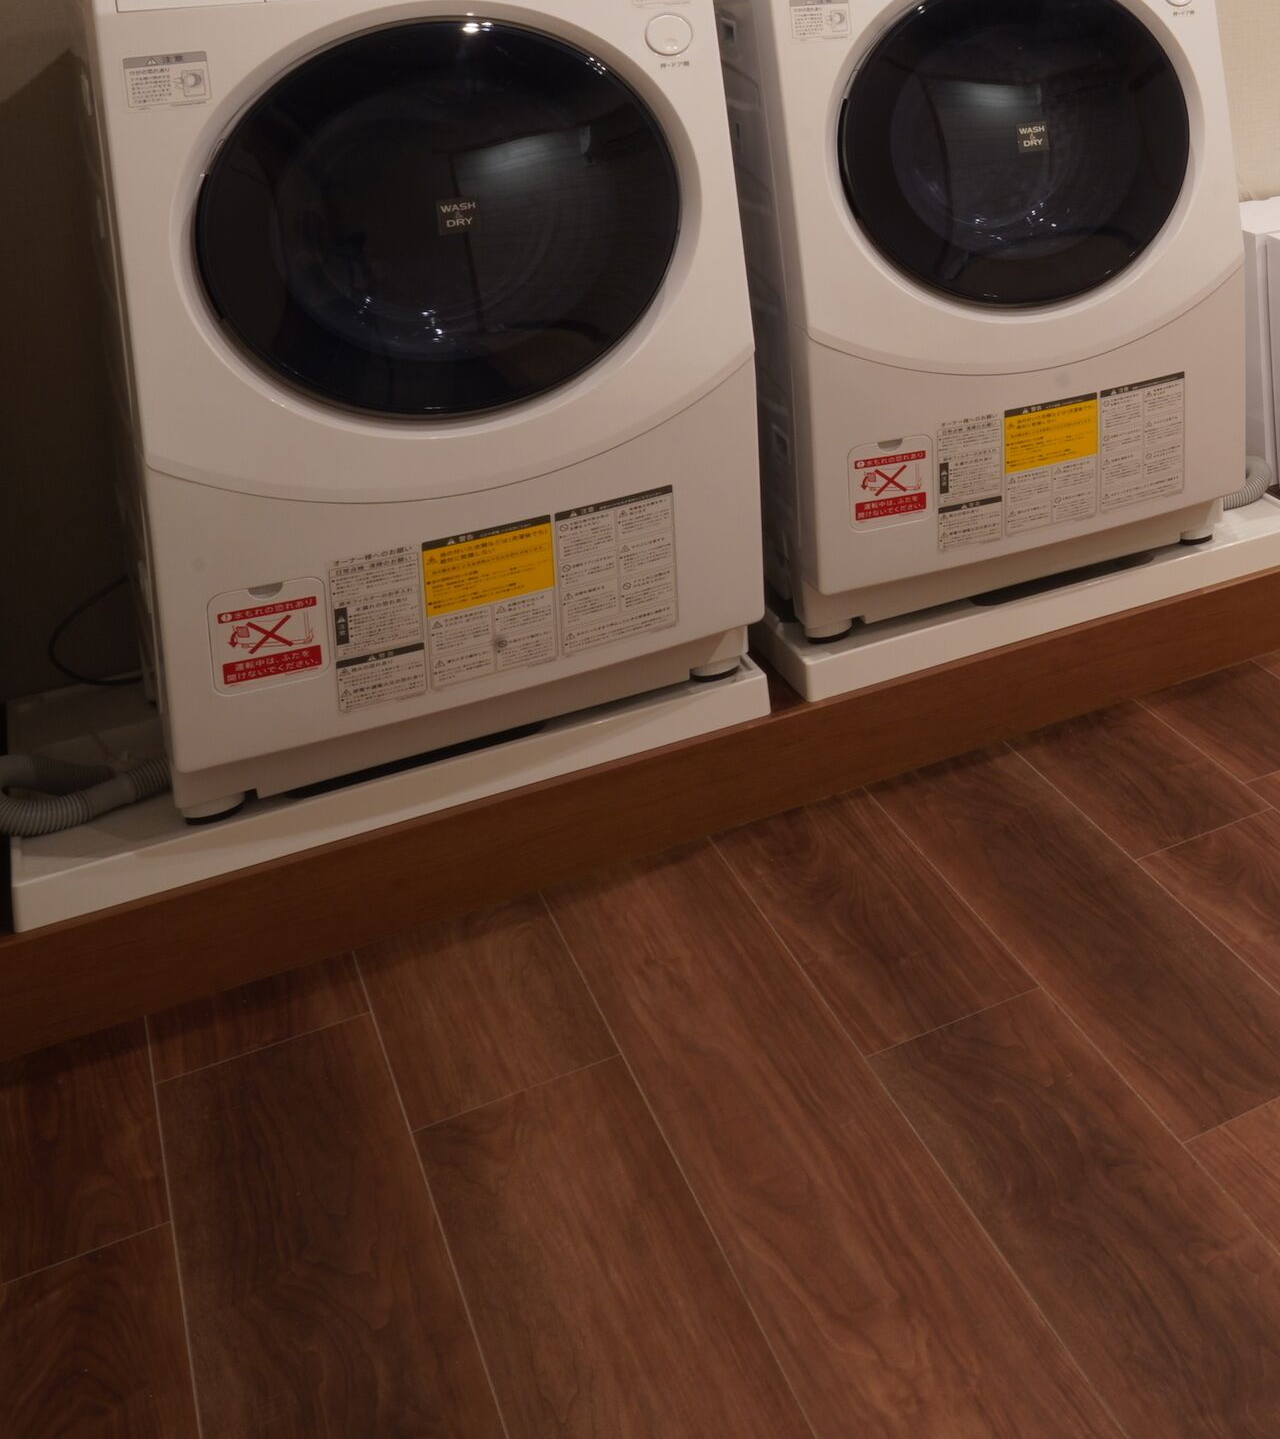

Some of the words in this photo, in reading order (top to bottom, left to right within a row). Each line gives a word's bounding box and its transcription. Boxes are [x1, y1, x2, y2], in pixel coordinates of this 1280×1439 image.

[1018, 125, 1046, 135] WASH
[1023, 138, 1044, 147] DRY
[440, 201, 476, 214] WASH
[446, 217, 473, 228] DRY
[334, 546, 413, 567] オーナー様へのお願い
[233, 599, 315, 620] 水もれの恐れあり
[235, 651, 310, 671] 運転中は、ふたを
[226, 659, 320, 683] 開けないでください。
